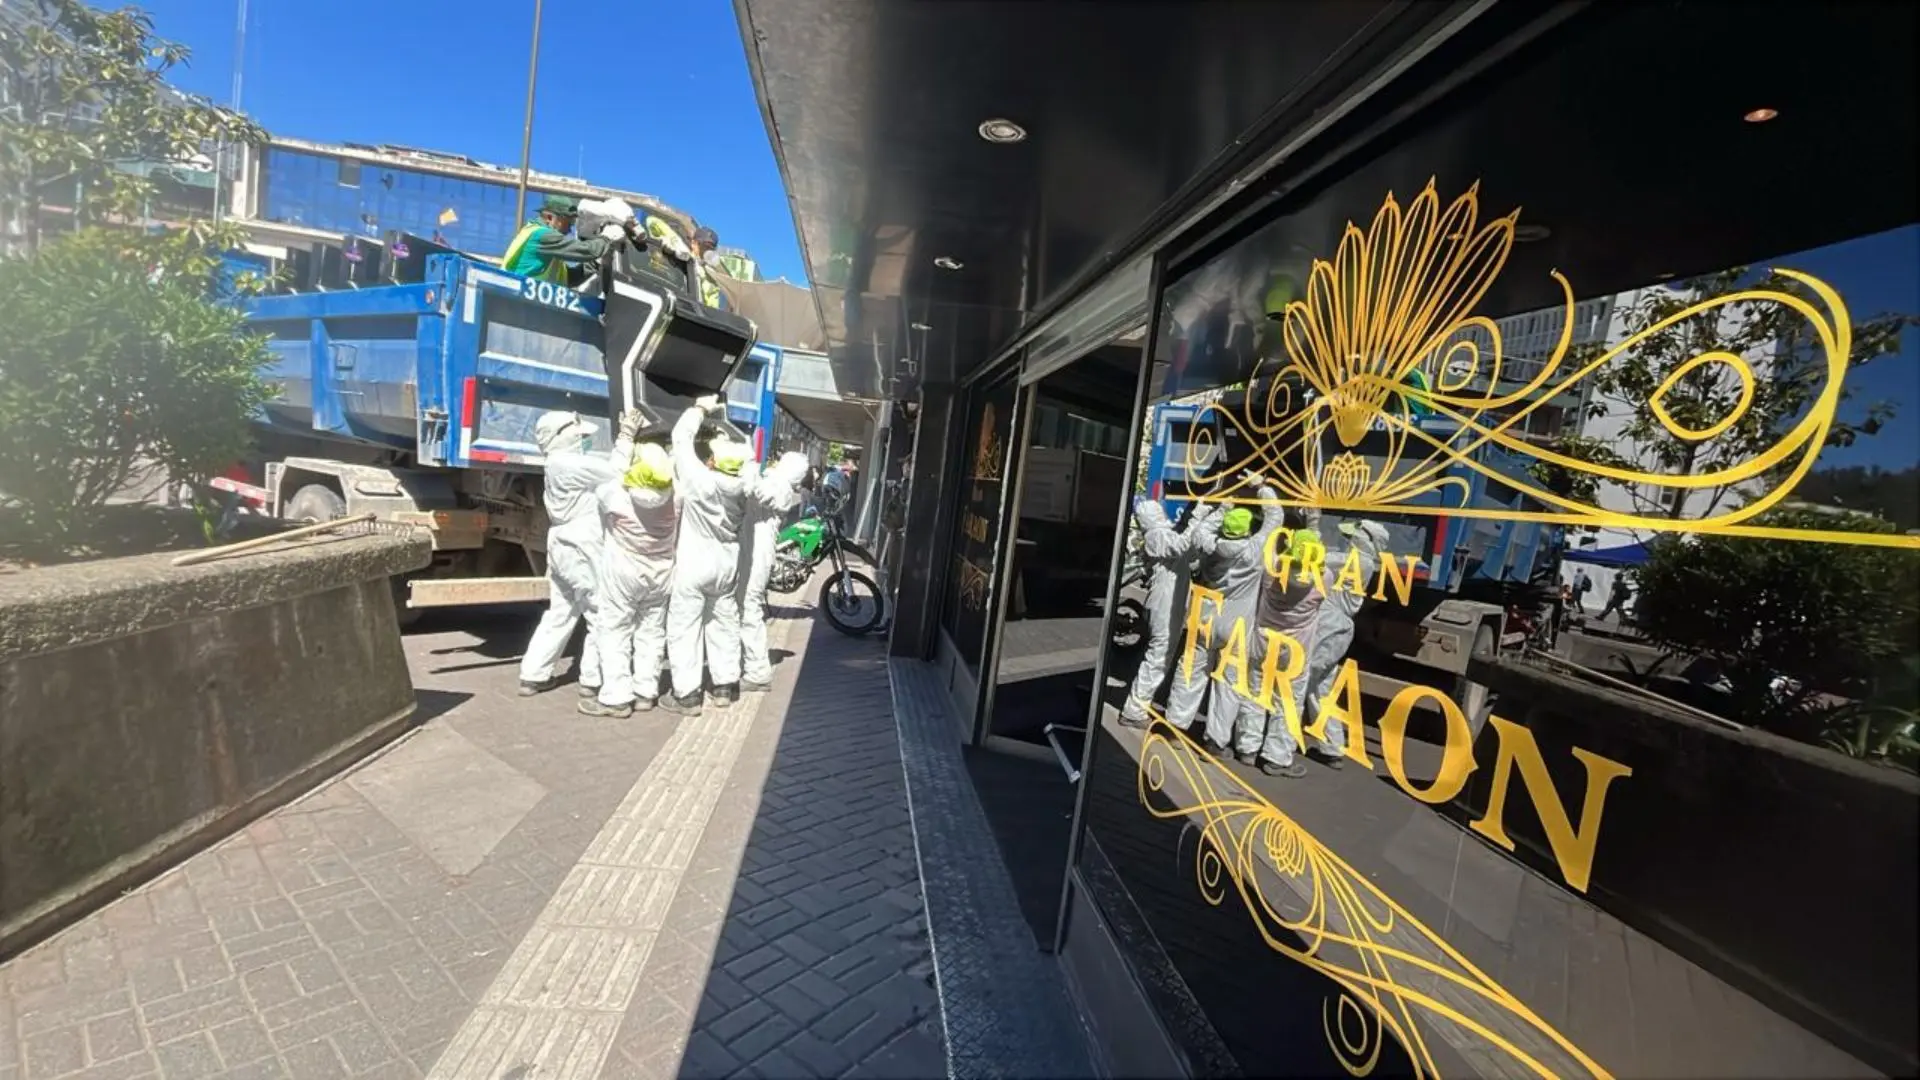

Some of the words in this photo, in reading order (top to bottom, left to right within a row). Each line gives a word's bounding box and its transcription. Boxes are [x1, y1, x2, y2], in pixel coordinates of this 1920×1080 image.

[524, 277, 581, 313] 3082
[1263, 527, 1423, 607] GRAN
[1183, 580, 1632, 893] FARAON
